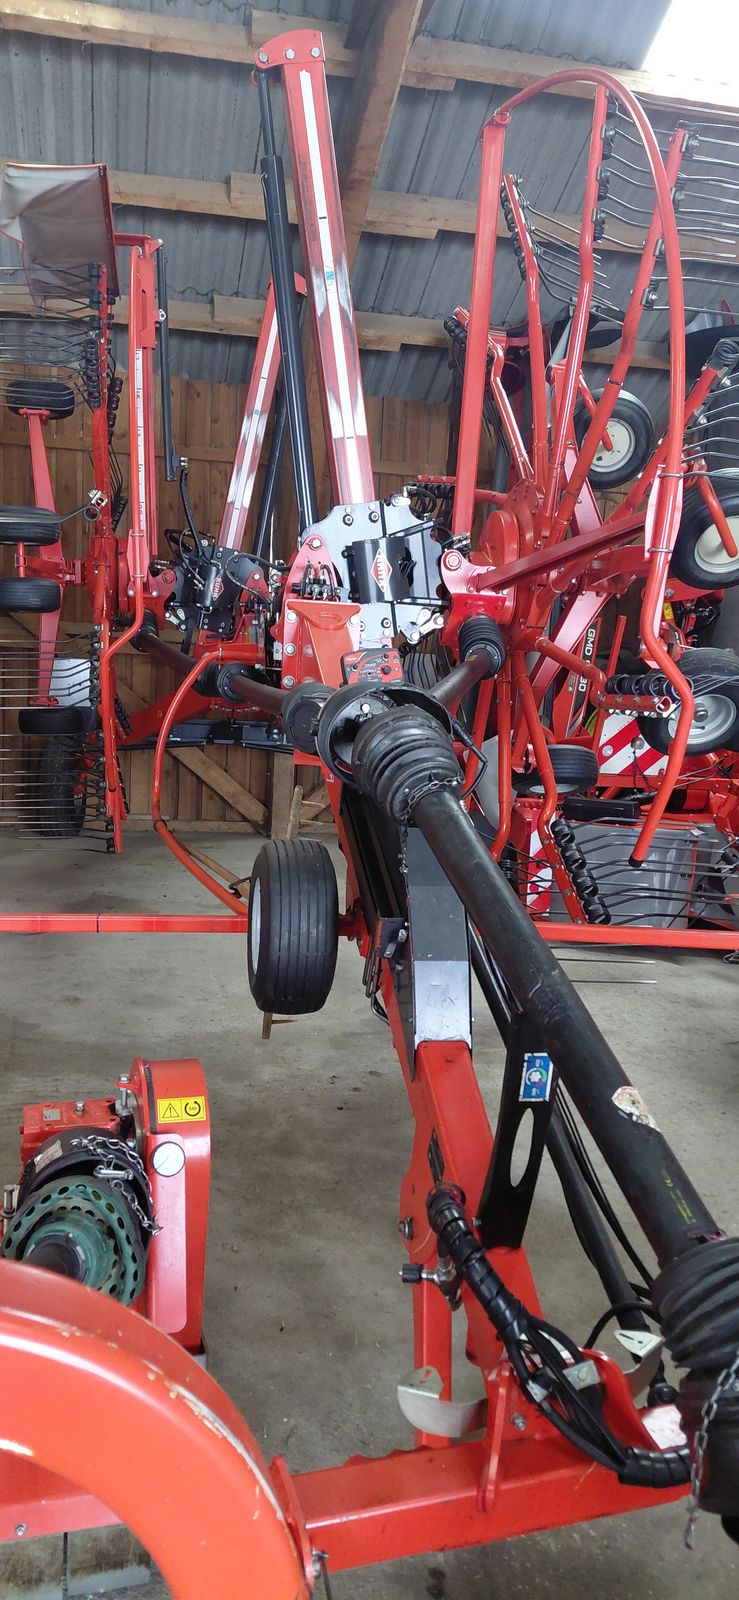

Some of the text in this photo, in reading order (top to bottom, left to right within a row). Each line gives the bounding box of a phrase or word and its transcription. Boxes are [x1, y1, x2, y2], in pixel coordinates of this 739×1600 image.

[375, 554, 387, 586] KUHN
[213, 575, 222, 598] KUHN
[585, 628, 596, 656] GMD
